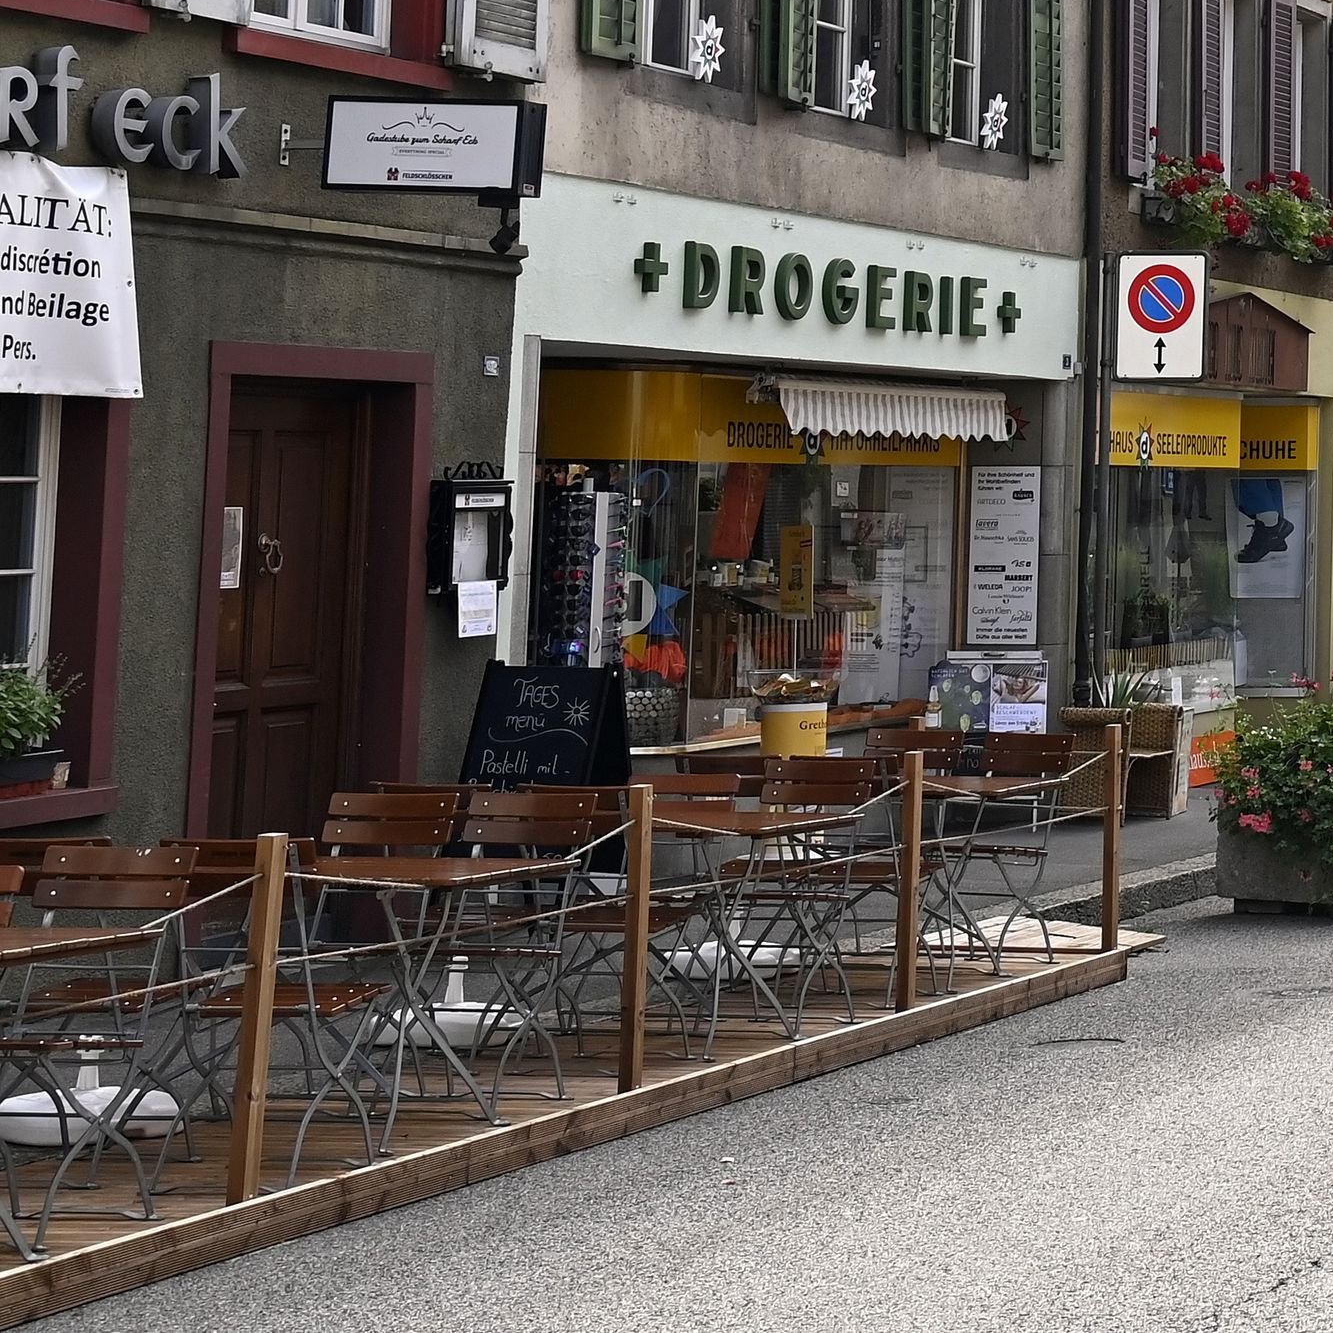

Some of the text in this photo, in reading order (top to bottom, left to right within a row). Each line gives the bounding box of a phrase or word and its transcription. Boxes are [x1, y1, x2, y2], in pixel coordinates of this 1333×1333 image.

[410, 136, 430, 146] zum
[0, 244, 102, 278] discrétion
[682, 240, 988, 338] DROGERIE
[28, 292, 110, 328] Beilage
[2, 334, 36, 361] Pers.
[726, 420, 794, 450] DROGERIE
[1156, 432, 1228, 458] SEELENPRODUKTE
[514, 676, 560, 709] TAGES
[506, 712, 546, 733] menü
[480, 748, 529, 776] Pastelli
